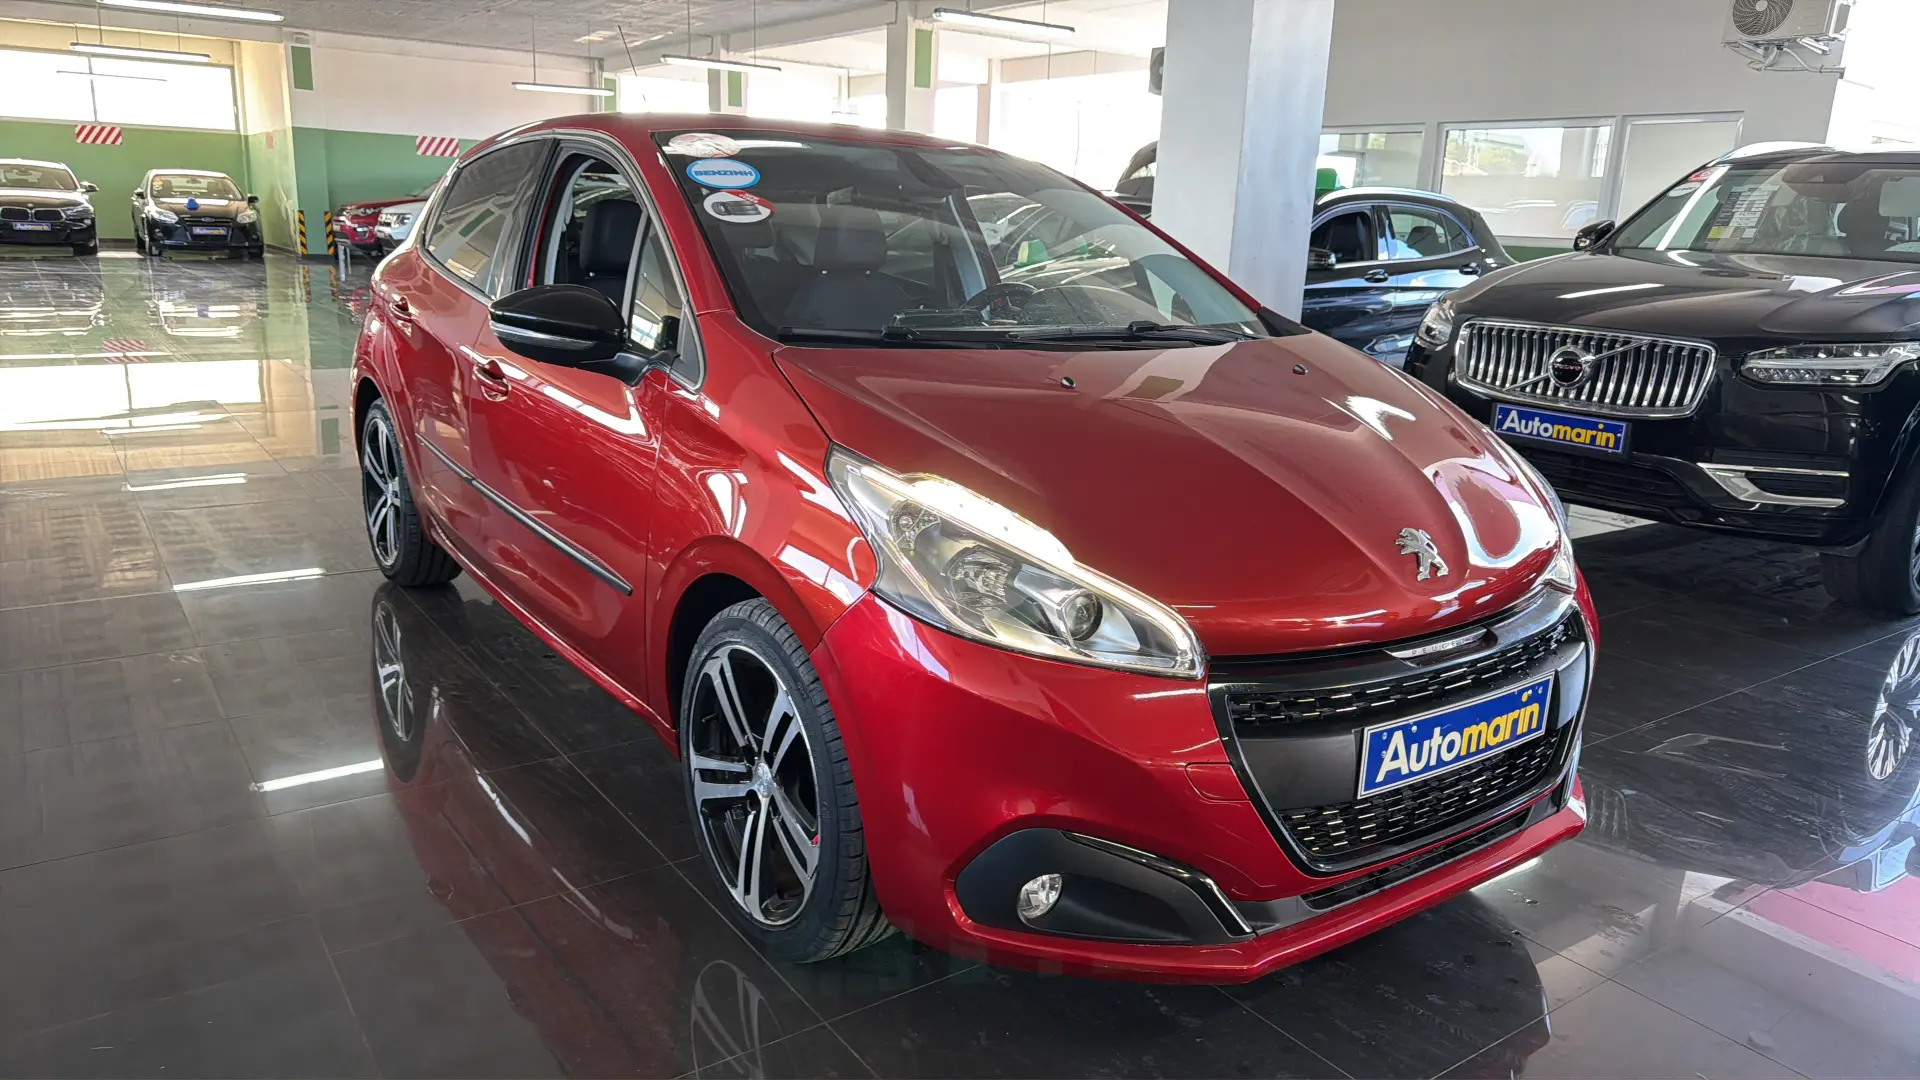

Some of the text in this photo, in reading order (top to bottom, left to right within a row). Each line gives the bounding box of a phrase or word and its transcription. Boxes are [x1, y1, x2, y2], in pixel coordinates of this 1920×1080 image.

[1502, 410, 1615, 448] Automarin
[1411, 633, 1477, 656] PEUGE
[1375, 692, 1540, 783] Automarin
